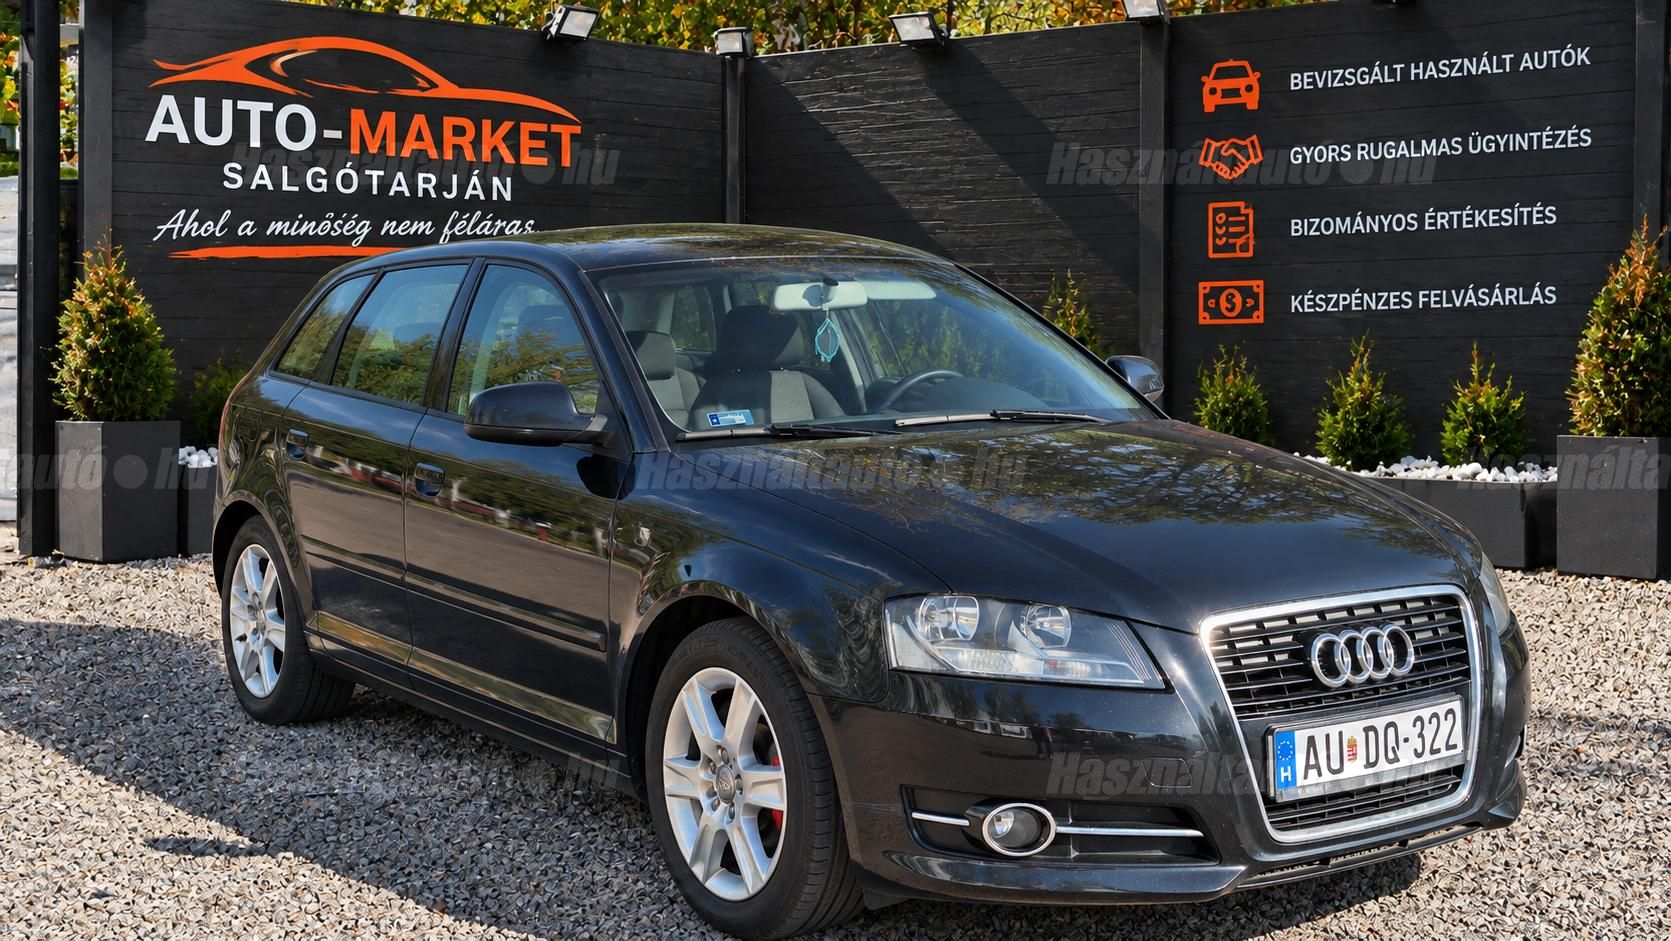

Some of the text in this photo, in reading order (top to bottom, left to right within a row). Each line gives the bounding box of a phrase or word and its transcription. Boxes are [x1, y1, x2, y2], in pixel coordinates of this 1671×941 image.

[1290, 44, 1591, 90] BEVIZSGÁLT HASZNÁLT AUTÓK
[145, 94, 582, 168] AUTO-MARKET
[1290, 125, 1592, 164] GYORS RUGALMAS ÜGYINTÉZÉS
[223, 162, 512, 201] SALGÓTARJÁN
[152, 208, 231, 241] Ahol
[237, 220, 257, 236] a
[380, 219, 435, 236] nem
[1290, 202, 1557, 237] BIZOMÁNYOS ÉRTÉKESÍTÉS
[1290, 282, 1557, 313] KÉSZPÉNZES FELVÁSÁRLÁS
[1303, 730, 1345, 780] AU
[1362, 708, 1458, 770] DQ-322
[1280, 766, 1292, 783] H
